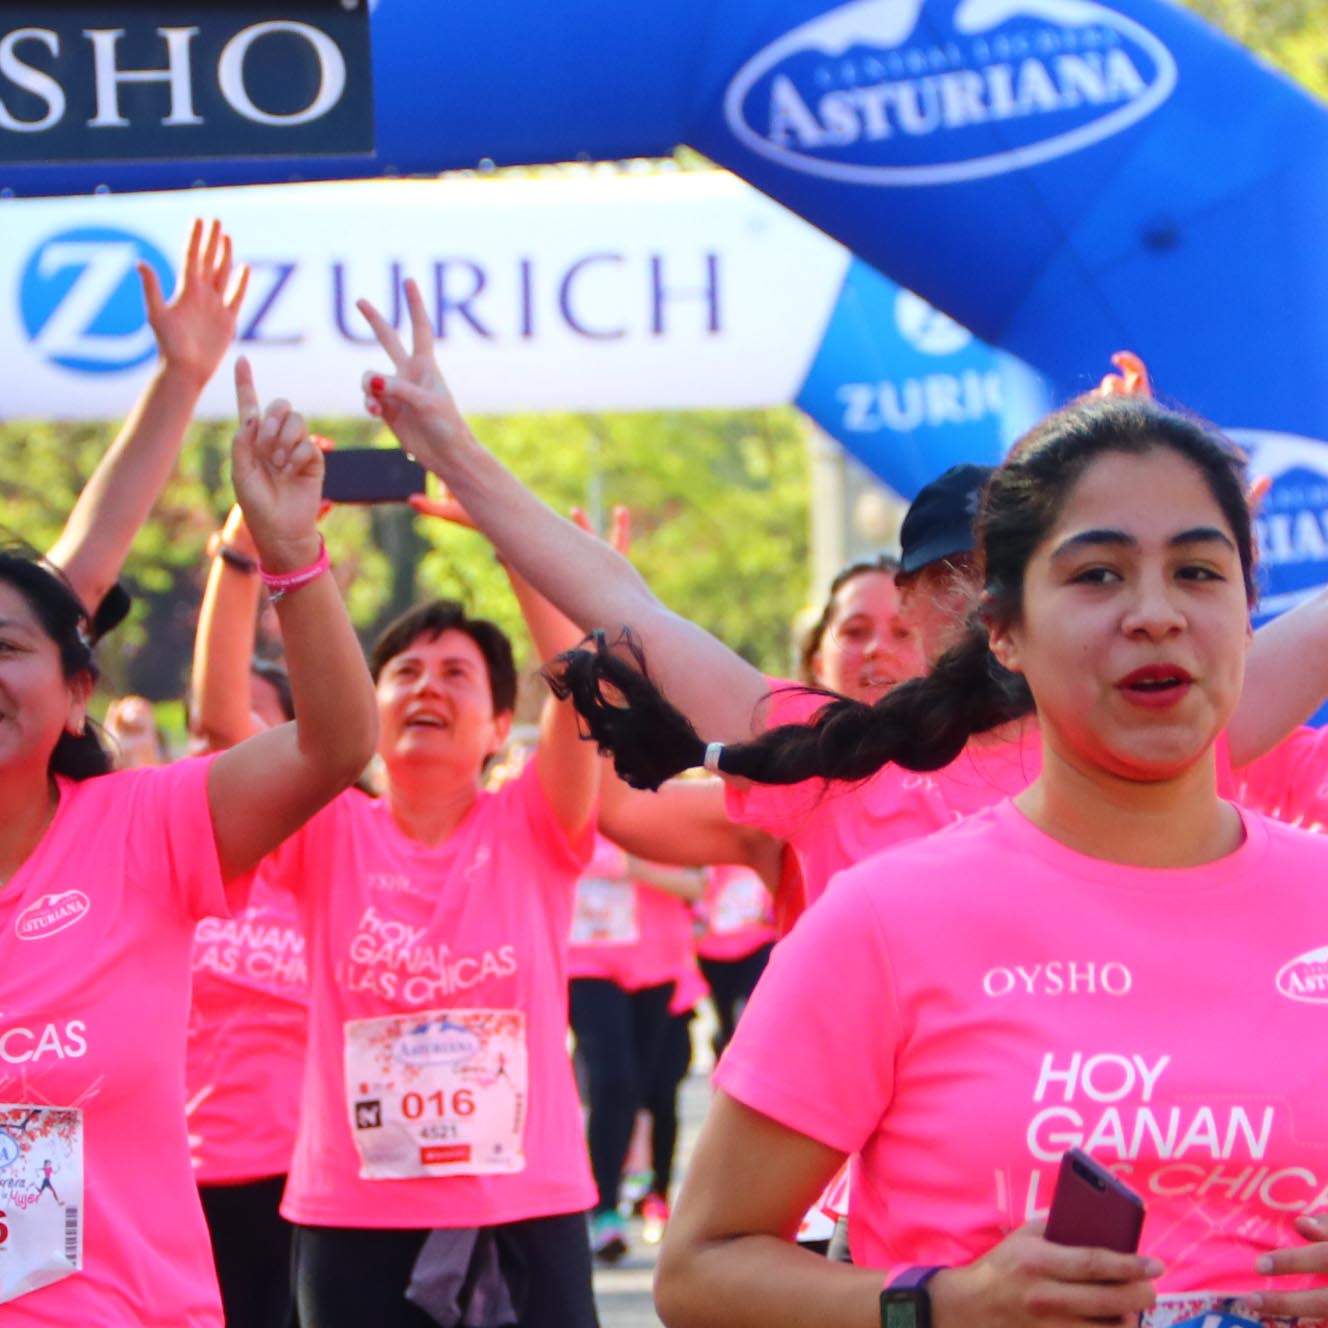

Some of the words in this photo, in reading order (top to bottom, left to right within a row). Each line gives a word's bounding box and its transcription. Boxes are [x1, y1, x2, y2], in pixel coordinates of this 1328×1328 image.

[768, 47, 1149, 149] ASTURIANA
[235, 252, 723, 346] ZURICH
[983, 961, 1133, 997] OYSHO
[1032, 1051, 1171, 1102] HOY
[401, 1088, 477, 1121] 016
[1026, 1105, 1274, 1162] GANAN
